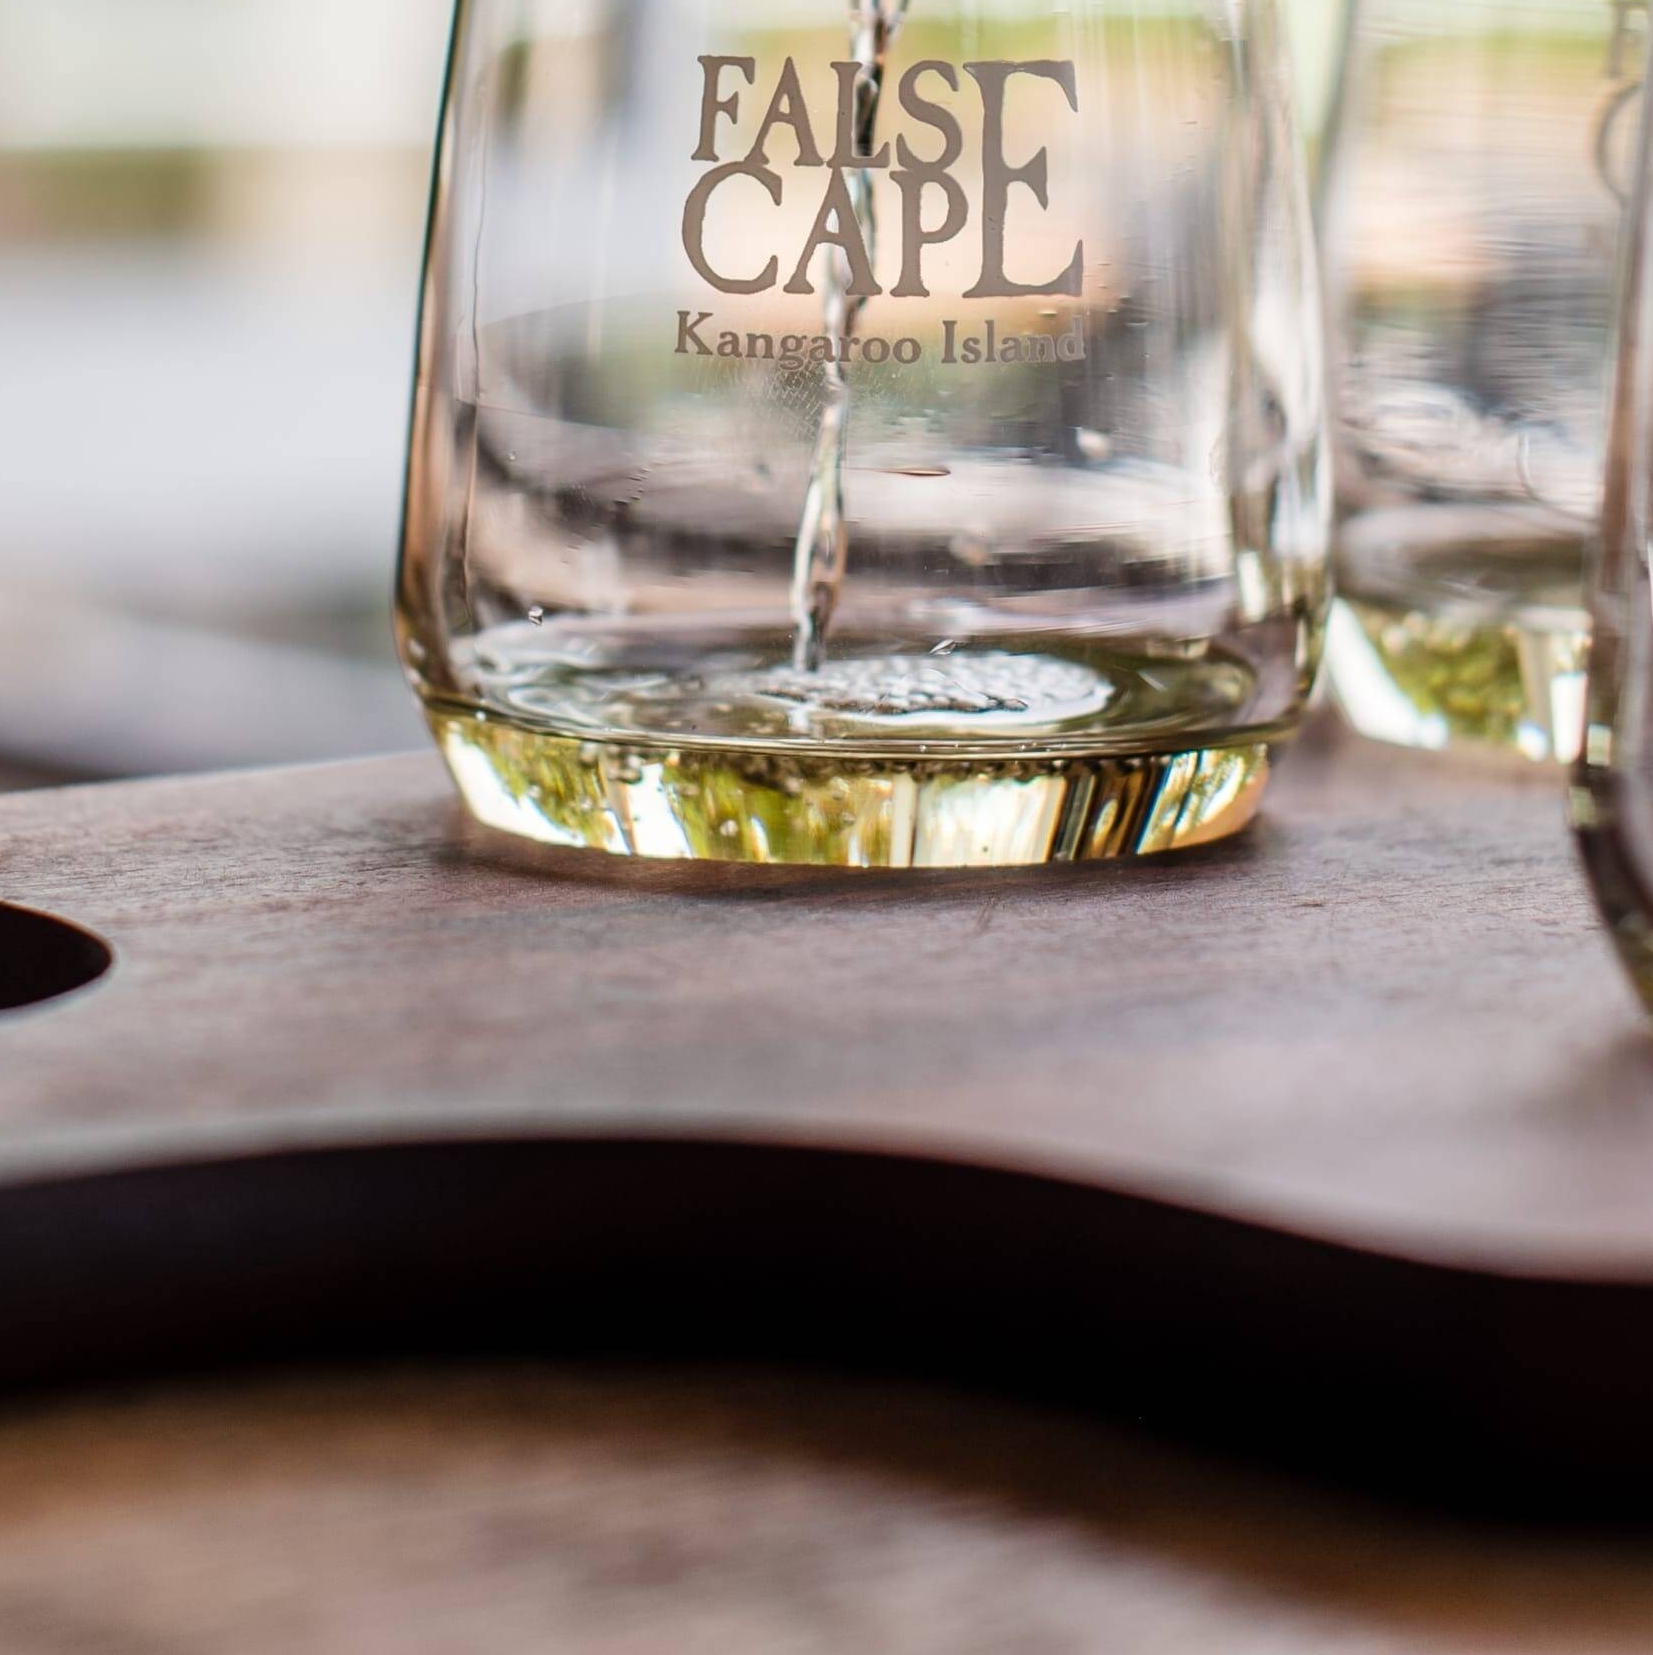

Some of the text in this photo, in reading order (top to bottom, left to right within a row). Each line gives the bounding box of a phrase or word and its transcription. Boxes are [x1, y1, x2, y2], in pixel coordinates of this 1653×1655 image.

[691, 54, 1079, 171] FALSE
[681, 159, 1084, 298] CAPE
[673, 309, 1087, 371] Kangaroo Island
